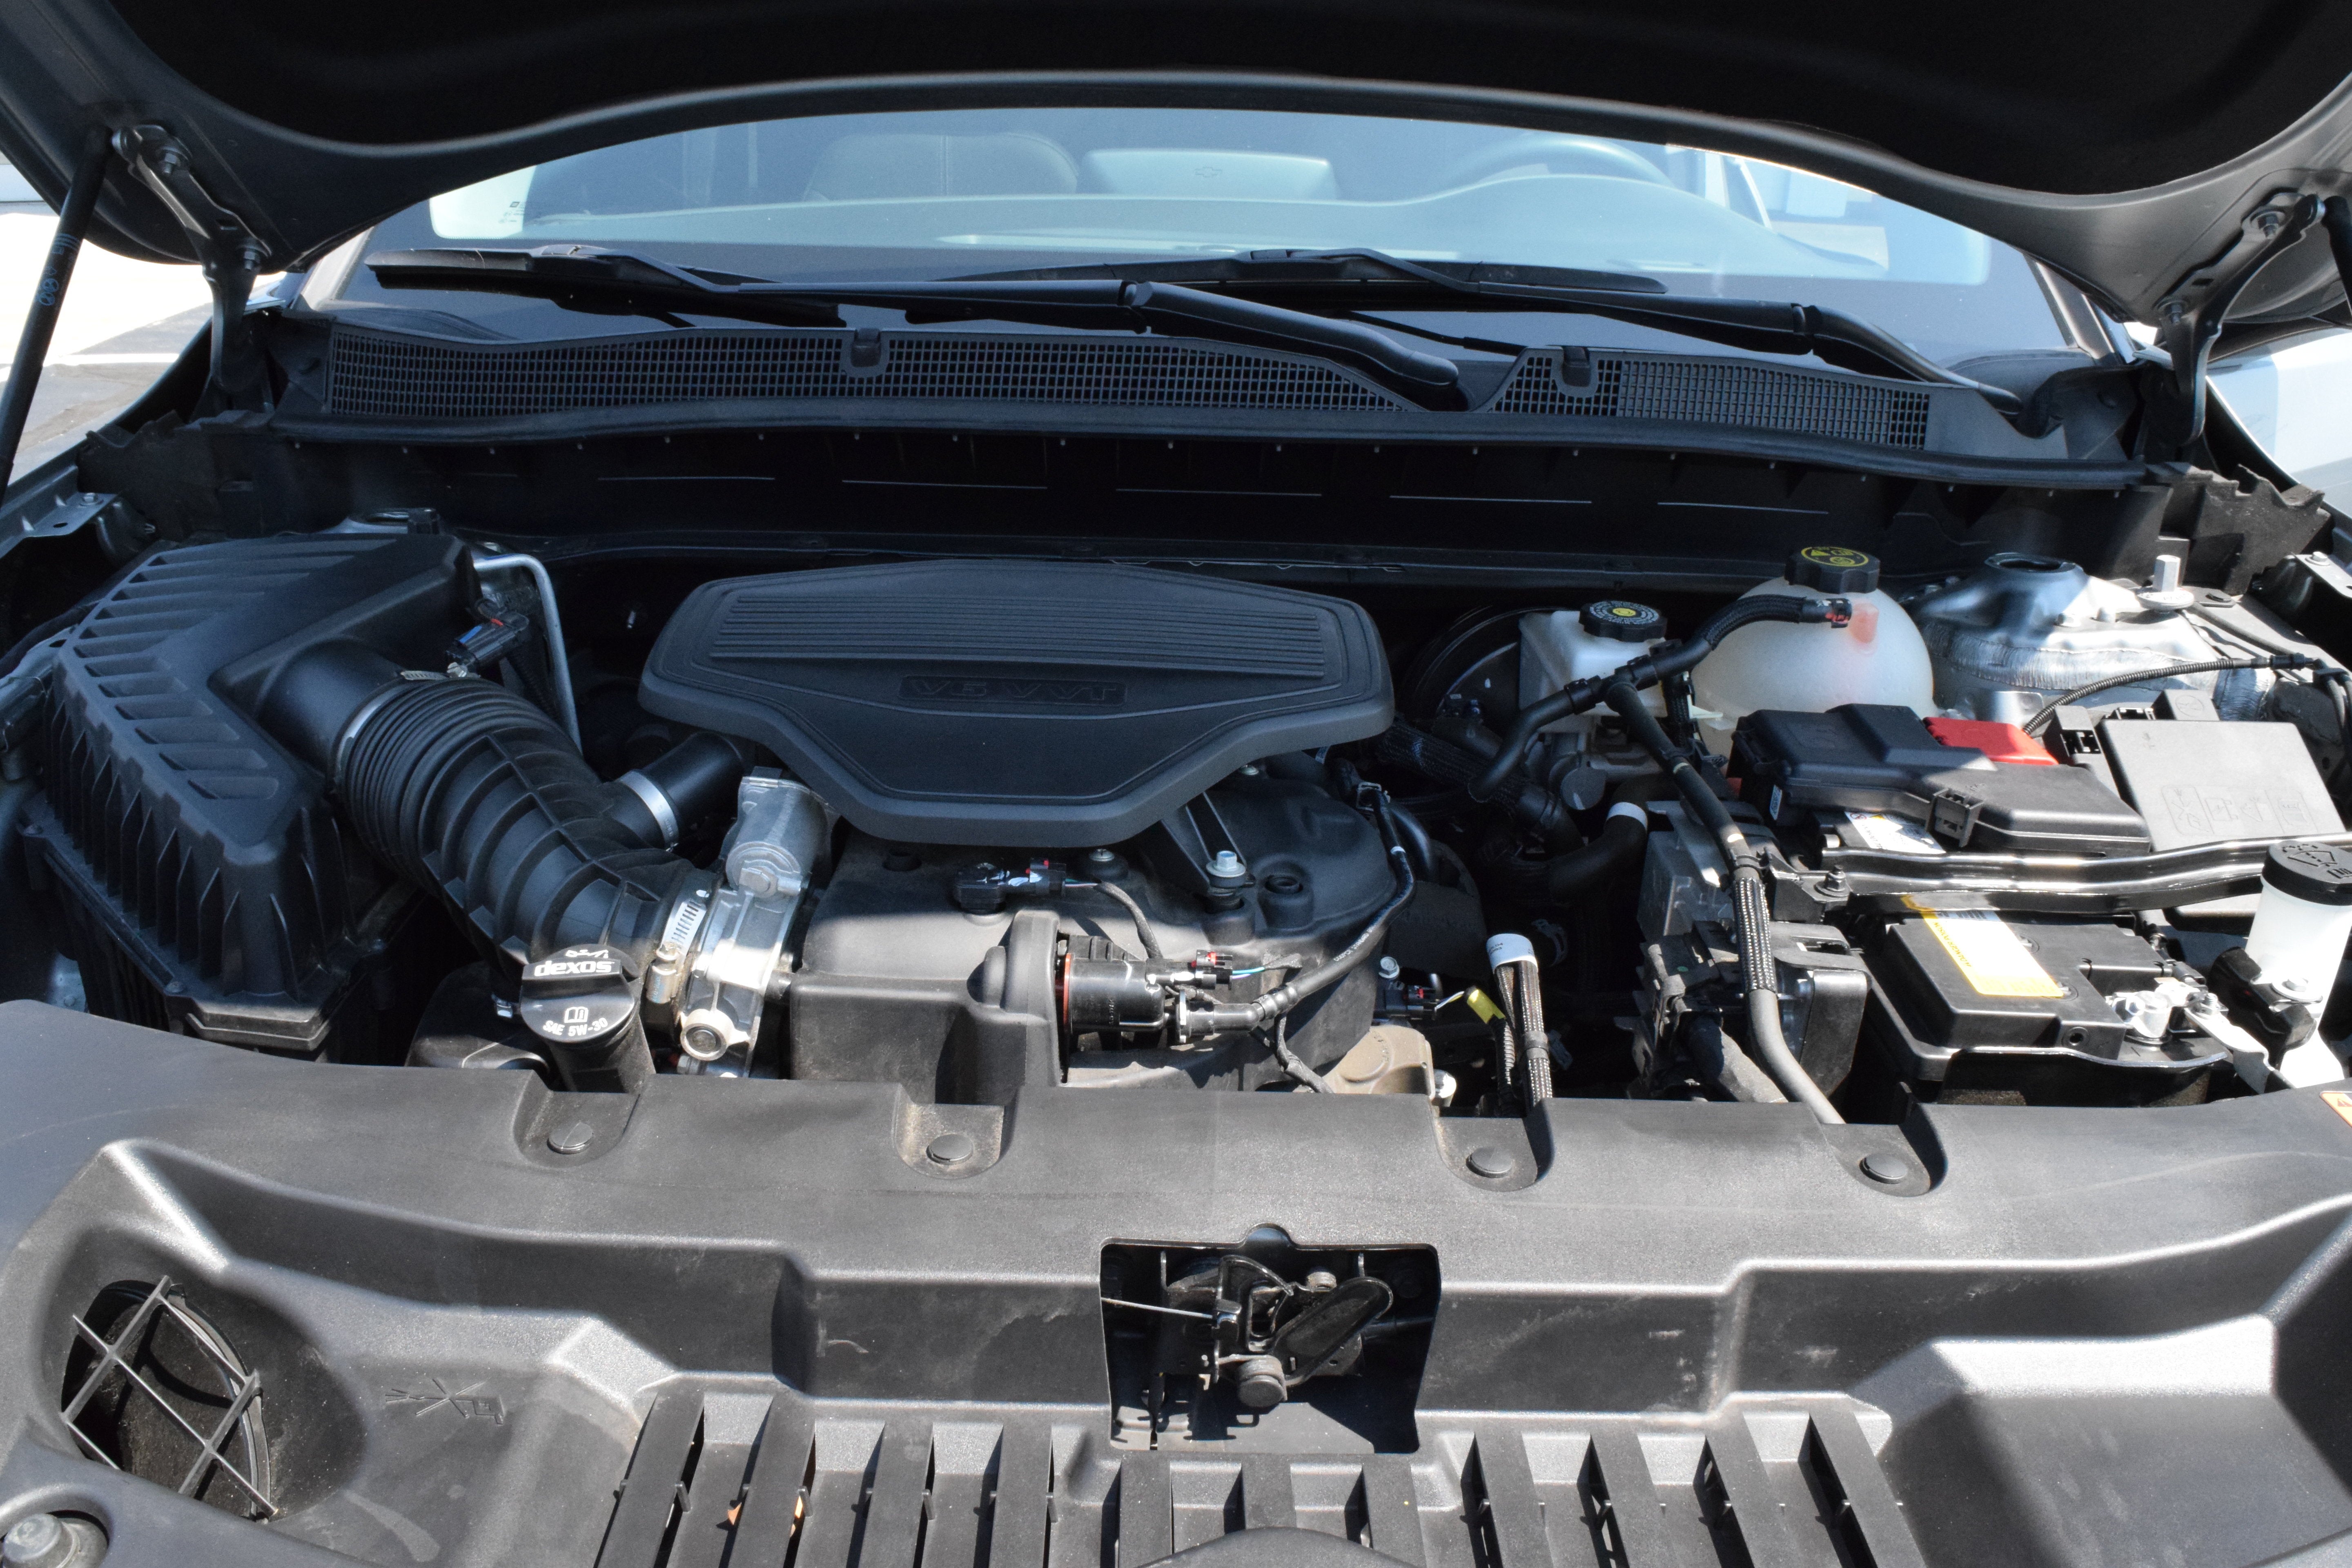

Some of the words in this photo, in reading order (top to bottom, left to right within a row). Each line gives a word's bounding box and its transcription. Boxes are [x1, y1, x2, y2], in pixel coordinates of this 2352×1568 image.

[911, 679, 988, 697] V6
[534, 960, 612, 977] dexos
[543, 1020, 565, 1036] SAE
[568, 1017, 608, 1036] 5W-30
